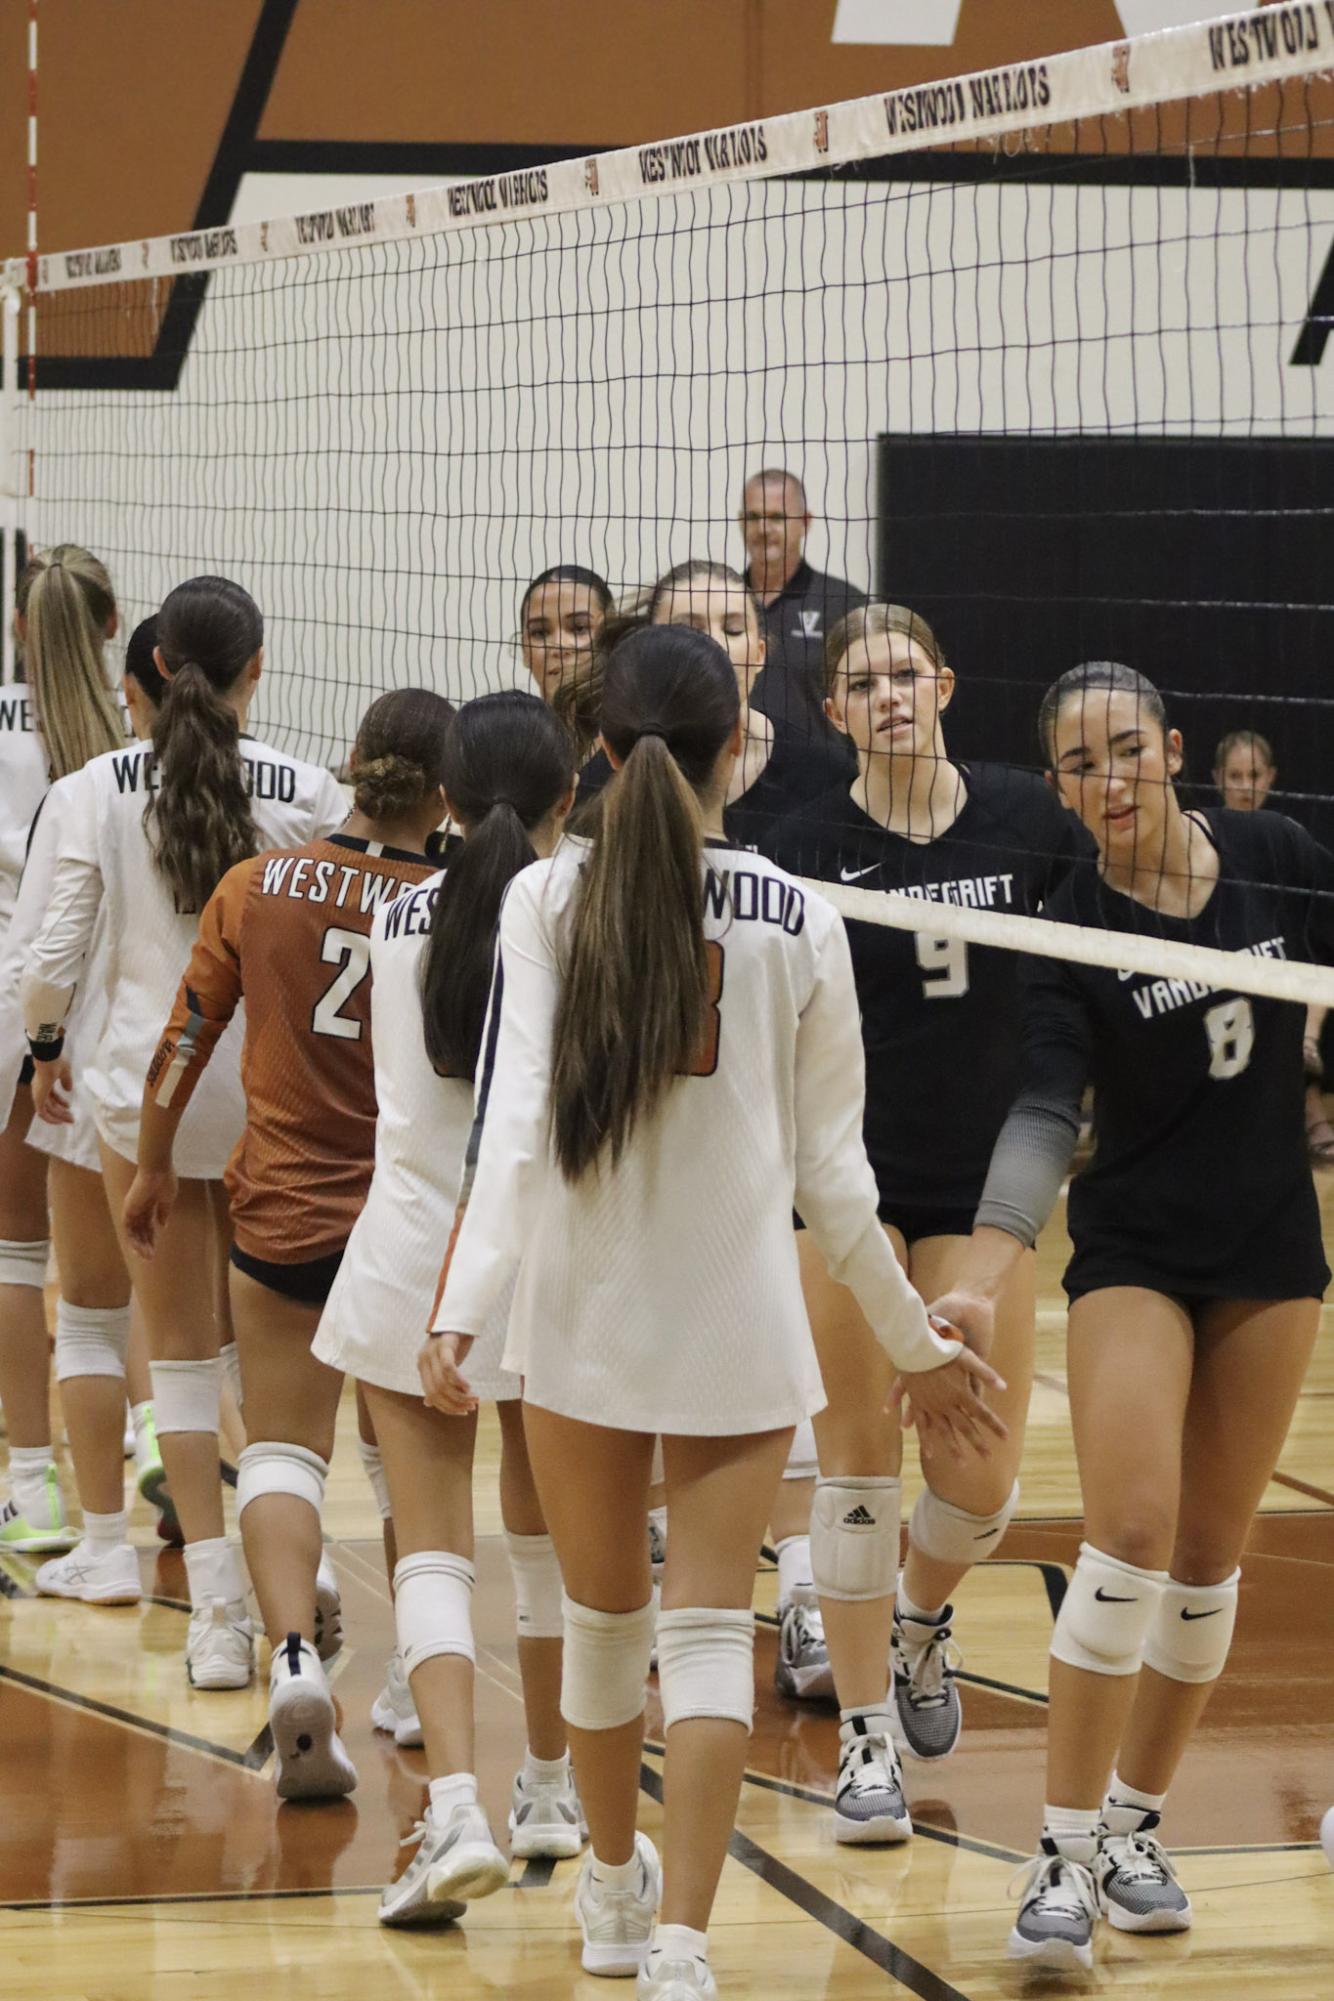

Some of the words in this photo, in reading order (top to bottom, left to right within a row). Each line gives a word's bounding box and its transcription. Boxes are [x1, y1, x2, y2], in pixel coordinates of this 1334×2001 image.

[312, 926, 371, 1041] 2
[914, 930, 970, 999] 9
[1203, 996, 1255, 1080] 8
